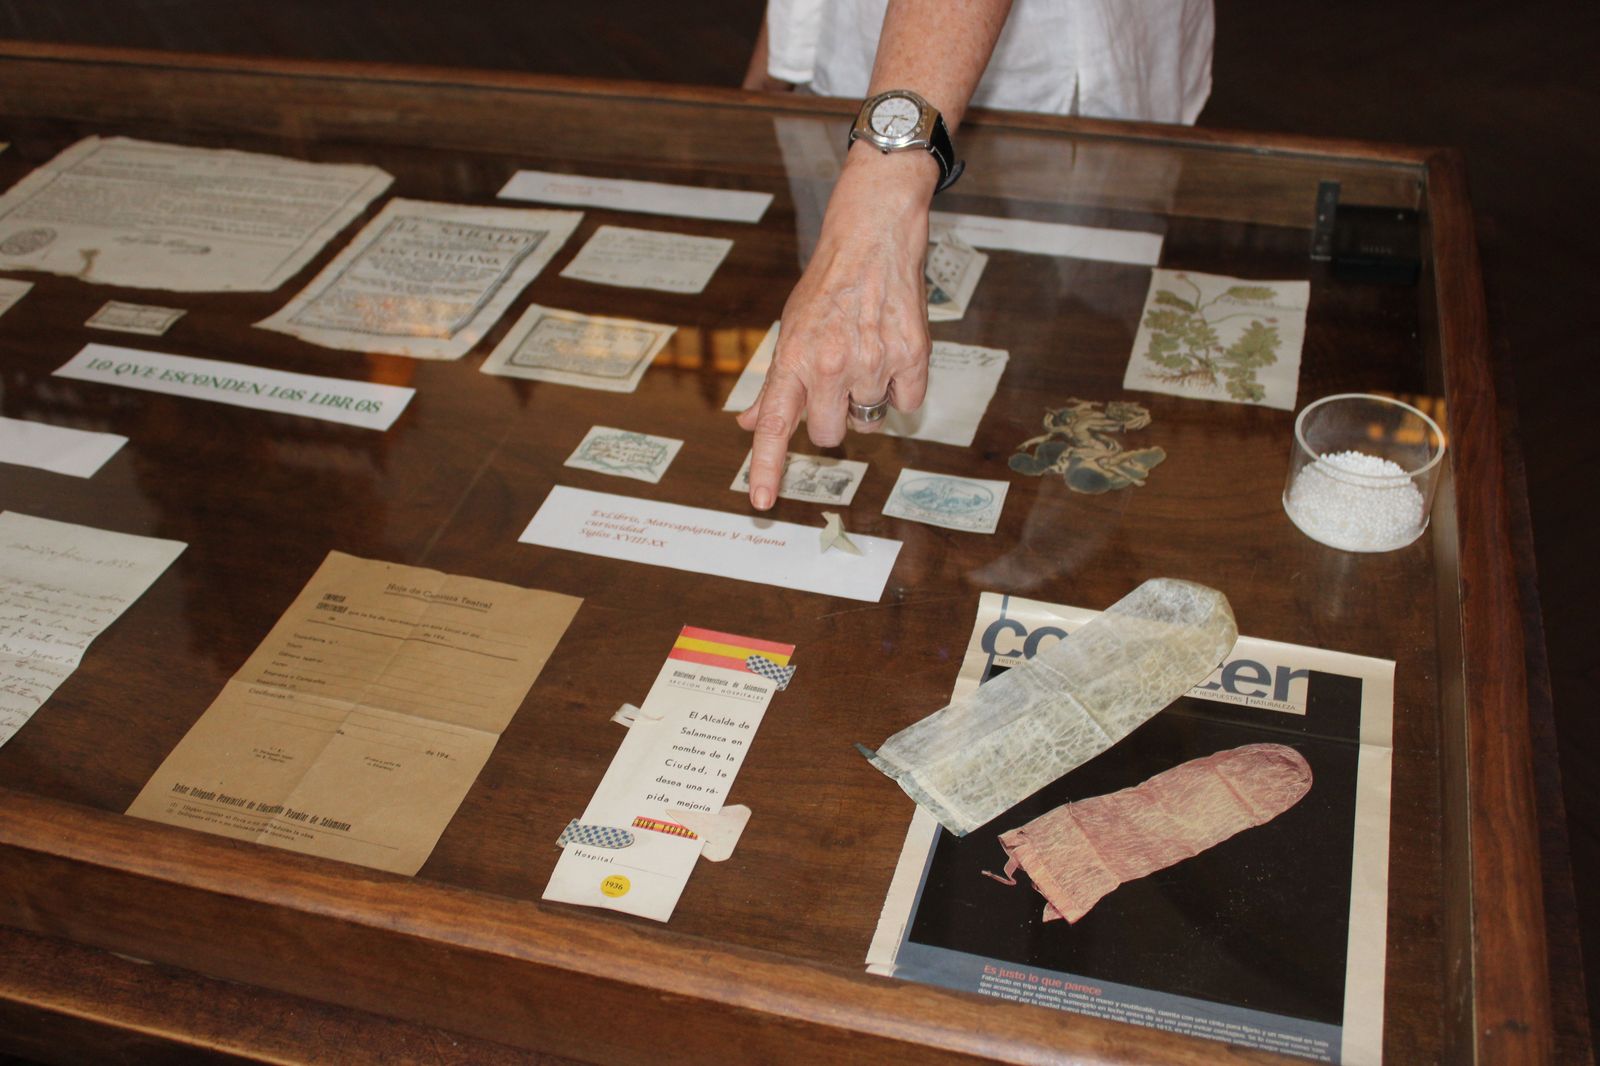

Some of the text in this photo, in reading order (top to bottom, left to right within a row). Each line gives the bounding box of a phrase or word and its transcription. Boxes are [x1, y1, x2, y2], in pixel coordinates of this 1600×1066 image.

[86, 357, 383, 412] LO QVE ESCONDEN LOS LIBROS
[579, 528, 610, 537] Siglos
[584, 520, 646, 534] curiosidad
[745, 534, 786, 547] Alguna
[386, 583, 408, 592] Hoja
[409, 586, 421, 595] de
[461, 597, 493, 609] Teatral
[699, 675, 729, 686] Universitaria
[743, 683, 767, 694] Salamanca
[721, 688, 764, 701] HOSPITALES
[1200, 691, 1243, 702] RESPUESTAS
[1250, 699, 1296, 710] NATURALEZA
[688, 711, 750, 730] El Alcalde de
[680, 726, 727, 743] Salamanca
[672, 744, 735, 762] nombre de la
[664, 758, 727, 778] Ciudad, le
[655, 775, 682, 788] desea
[686, 783, 702, 792] una
[172, 782, 190, 794] Señor
[189, 787, 216, 801] Delegado
[216, 794, 247, 807] Provincial
[246, 800, 256, 810] de
[285, 808, 310, 822] Popular
[309, 814, 319, 824] de
[646, 793, 711, 812] pida mejoría
[574, 849, 614, 864] Hospital
[605, 880, 624, 890] 1936
[983, 964, 1103, 996] Es justo lo que parece
[979, 981, 993, 989] que
[1022, 989, 1034, 997] por
[1035, 992, 1061, 1003] ejemplo,
[1107, 1007, 1125, 1015] leche
[1126, 1011, 1144, 1019] antes
[1177, 1021, 1193, 1029] para
[981, 974, 1012, 985] Fabricado
[1022, 982, 1038, 991] tripa
[1047, 987, 1066, 997] cerdo,
[1068, 992, 1089, 1001] cosido
[1095, 998, 1115, 1006] mano
[1158, 1010, 1180, 1019] cuenta
[1225, 1023, 1241, 1031] para
[991, 990, 1001, 998] de
[1018, 996, 1030, 1004] por
[1031, 997, 1038, 1005] la
[1038, 998, 1060, 1009] ciudad
[1145, 1020, 1155, 1028] de
